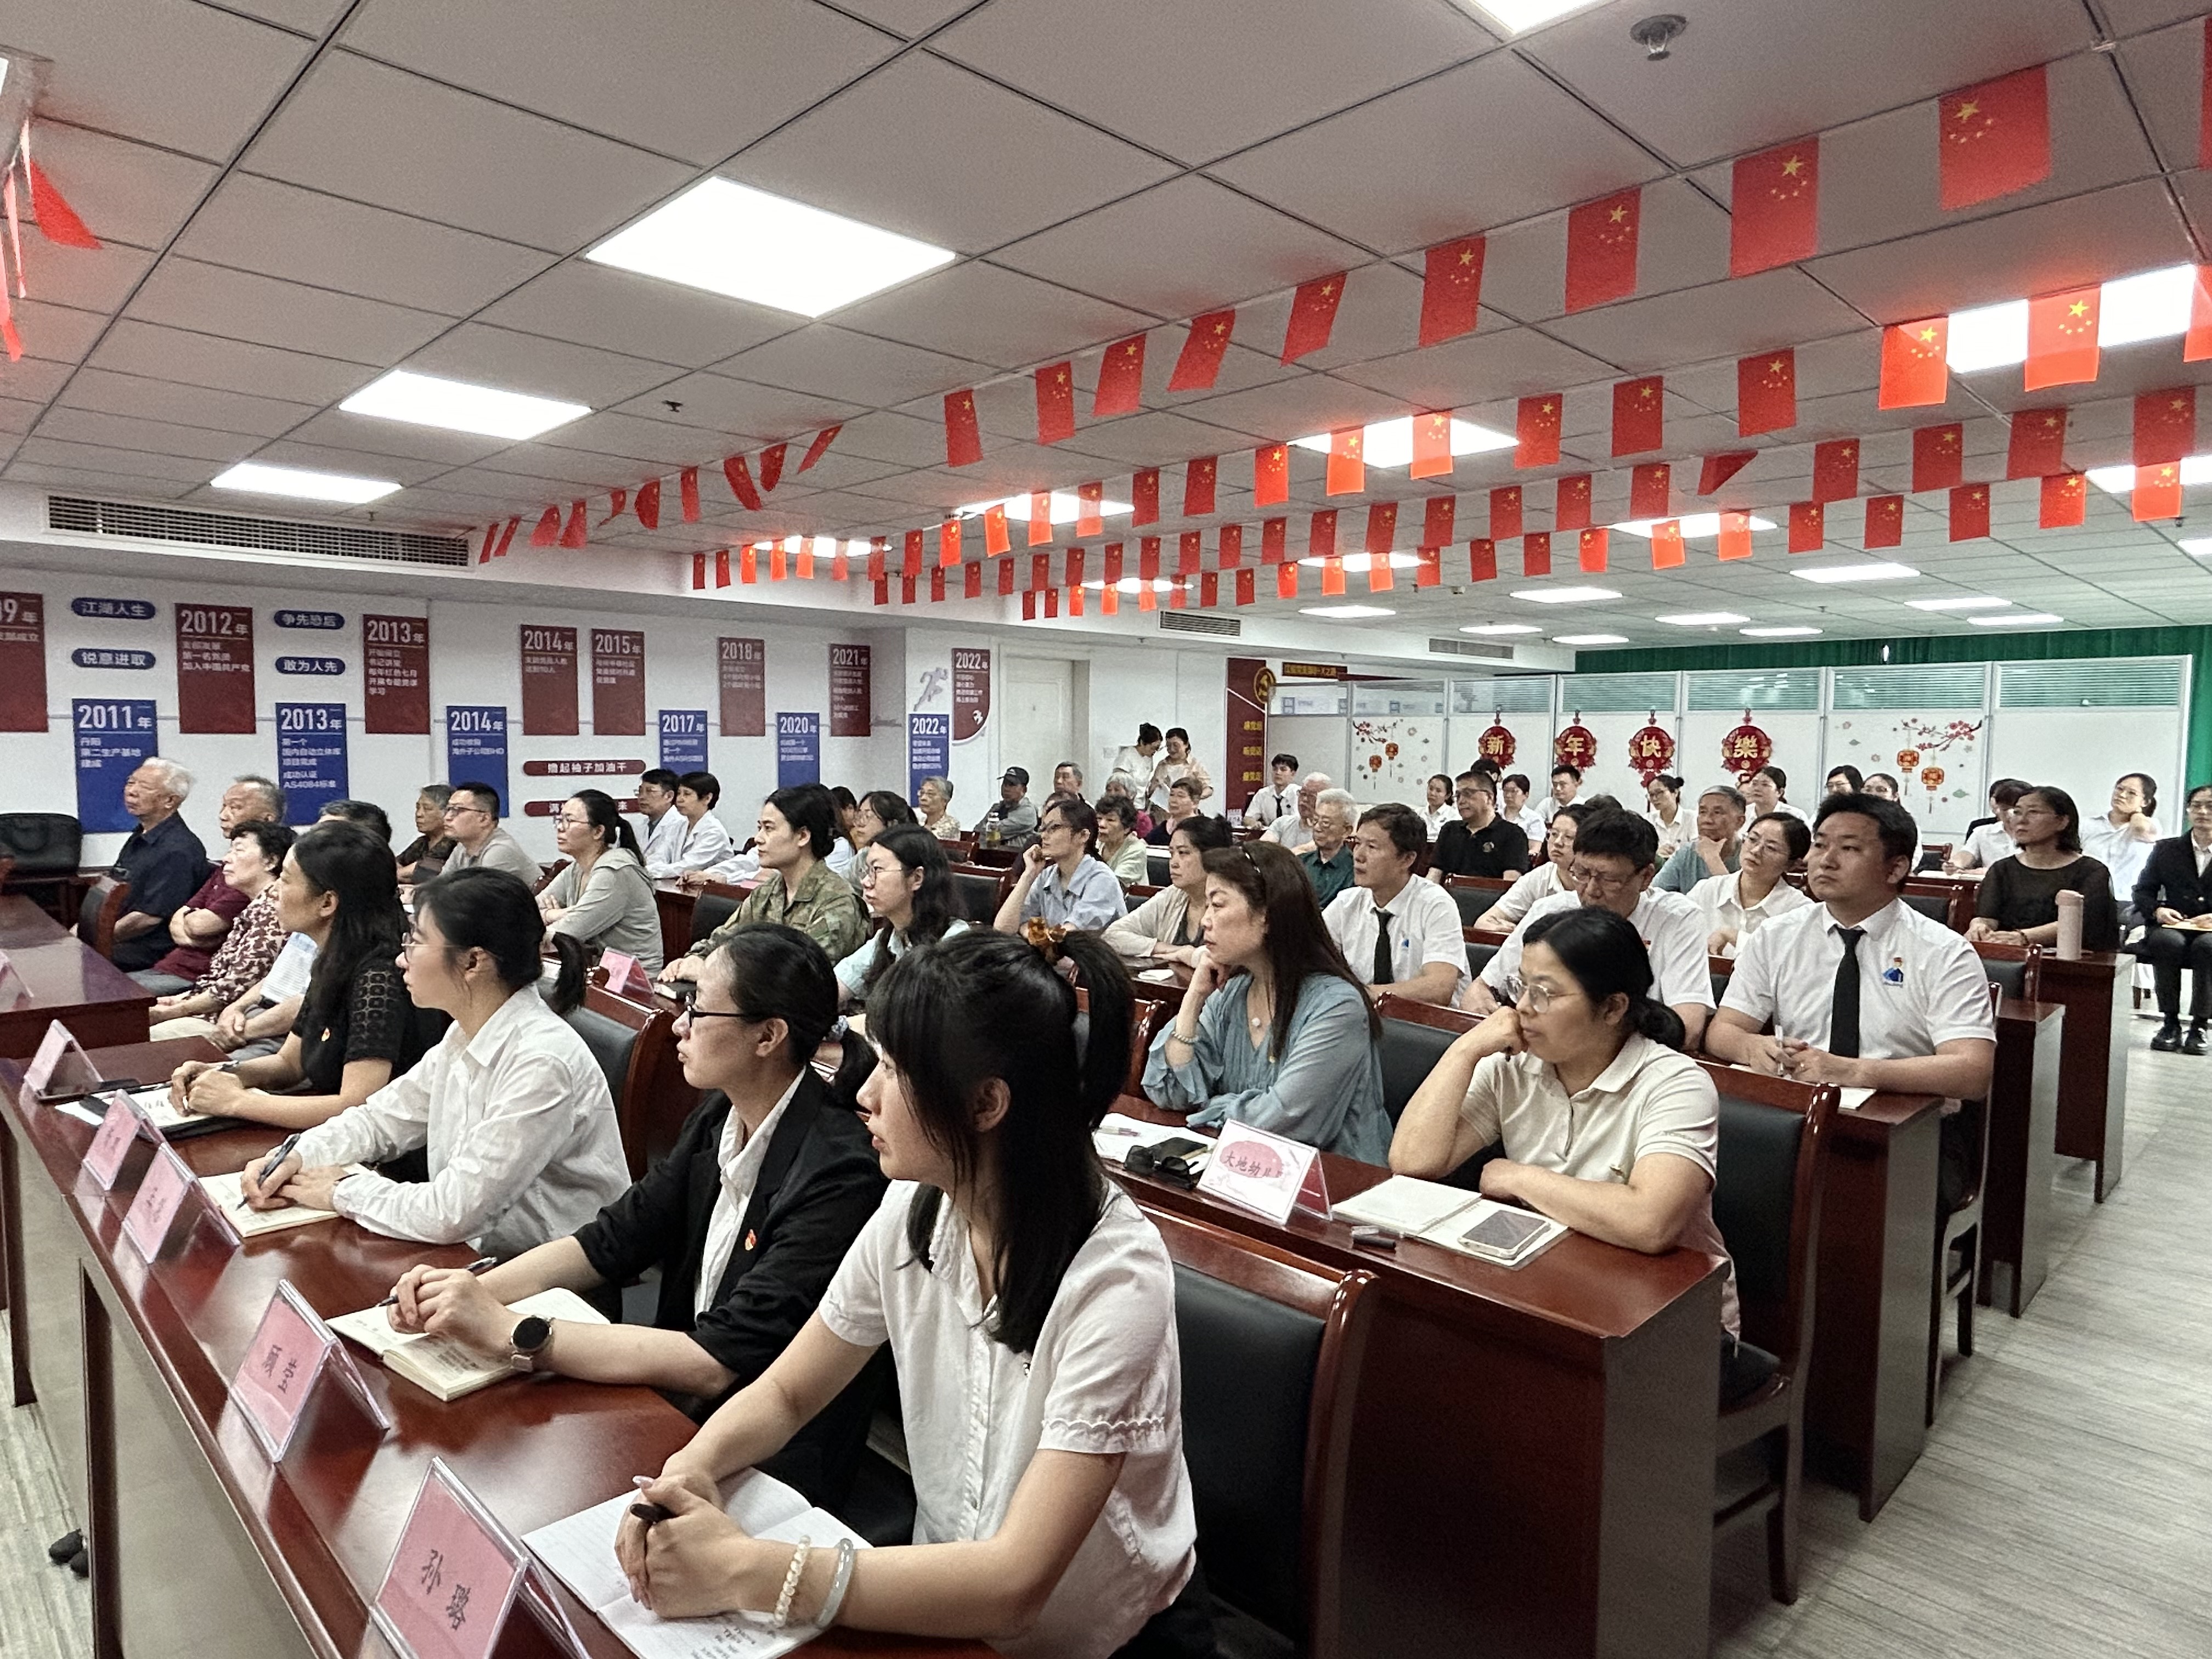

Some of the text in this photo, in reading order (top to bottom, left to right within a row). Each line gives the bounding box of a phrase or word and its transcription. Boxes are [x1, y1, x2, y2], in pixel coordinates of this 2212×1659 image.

[0, 598, 38, 623] 9年
[81, 601, 146, 617] 江湖人生
[181, 610, 249, 635] 2012年
[281, 613, 336, 626] 争先恐后
[367, 620, 425, 643] 2013年
[524, 630, 574, 651] 2014年
[595, 634, 641, 654] 2015年
[722, 642, 761, 660] 2018年
[81, 651, 146, 665] 锐意进取
[833, 648, 868, 665] 2021年
[956, 652, 988, 669] 2022年
[283, 659, 337, 673] 敢为人先
[78, 704, 152, 729] 2011年
[281, 708, 342, 730] 2013年
[450, 710, 504, 731] 2014年
[662, 714, 704, 733] 2017年
[780, 716, 817, 733] 2020年
[912, 718, 947, 734] 2022年
[1486, 735, 1758, 759] 新 年 快 樂
[548, 762, 627, 774] 撸起袖子加油干
